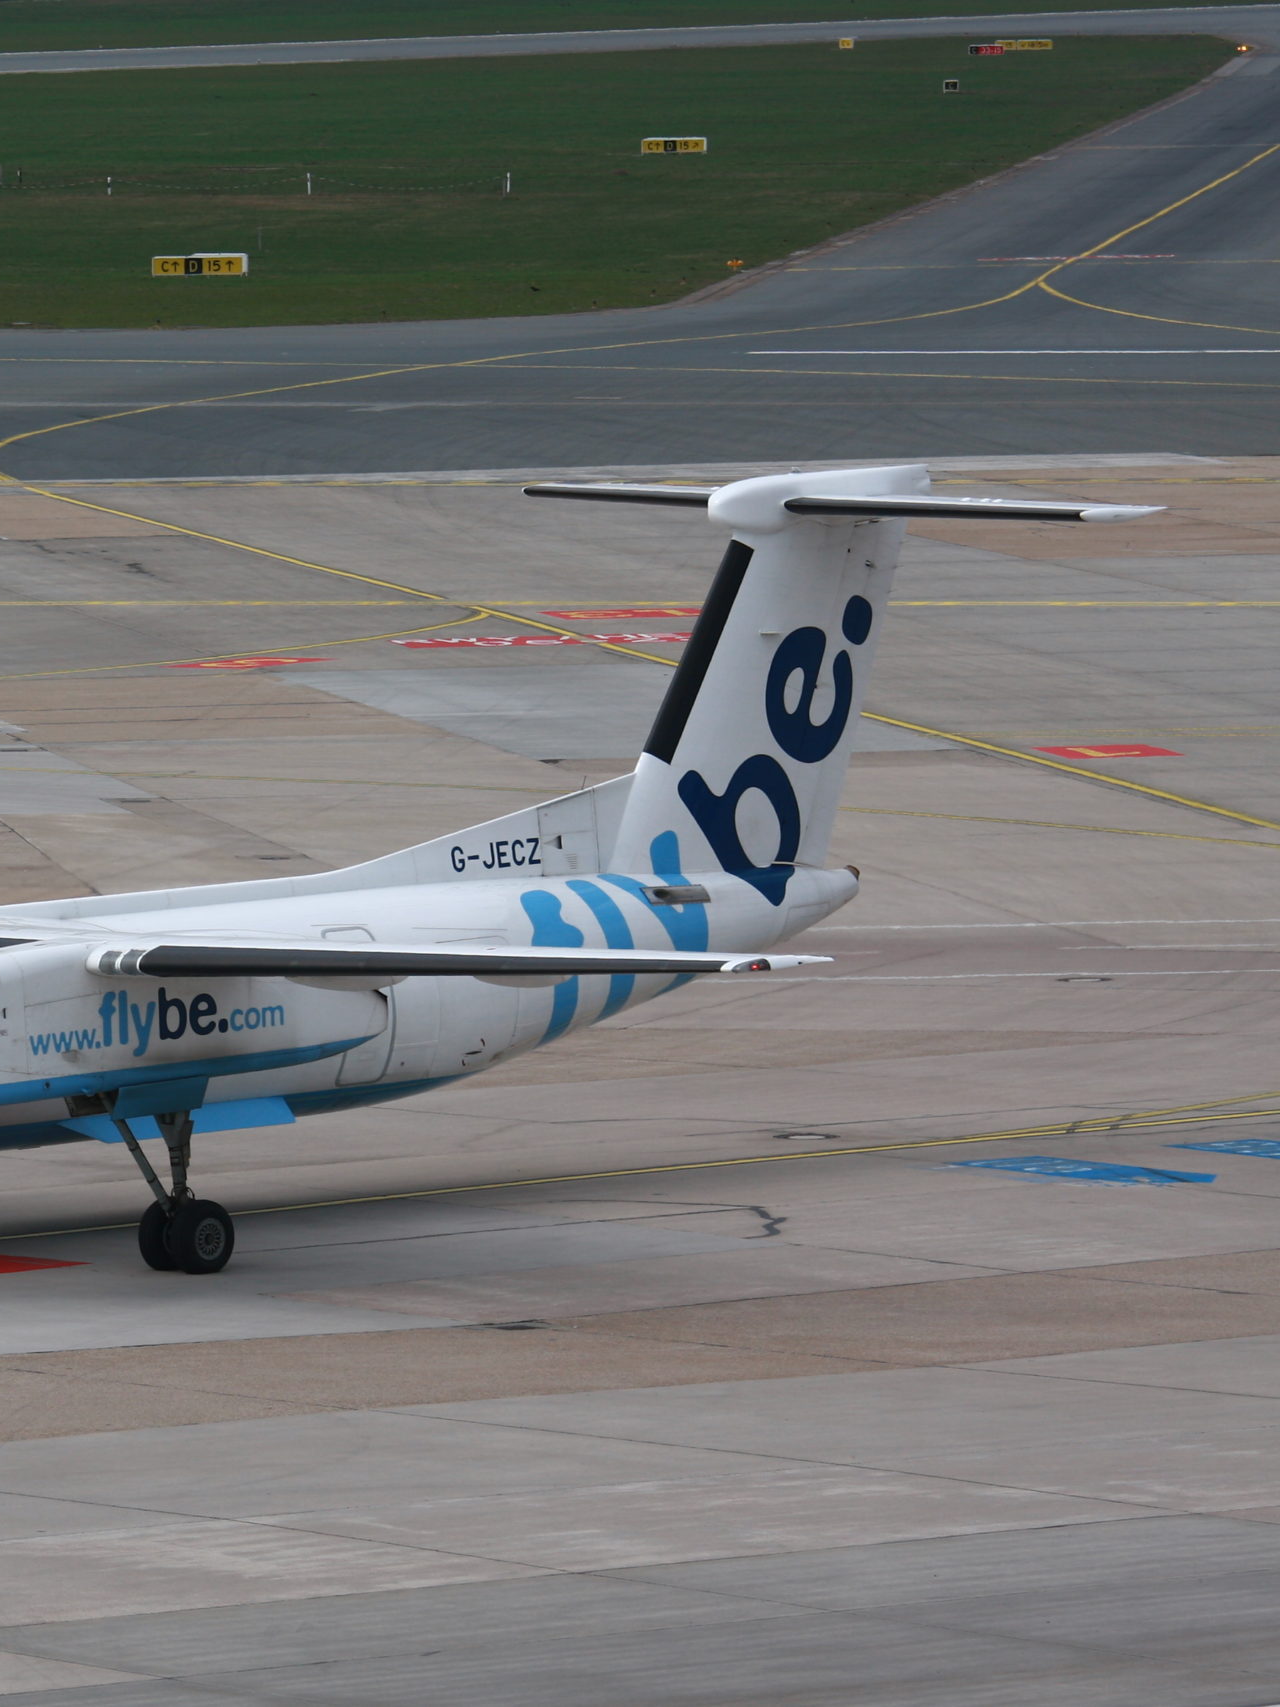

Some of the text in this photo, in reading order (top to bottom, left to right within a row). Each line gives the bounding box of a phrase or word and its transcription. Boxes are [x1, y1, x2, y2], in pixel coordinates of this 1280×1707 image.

[647, 142, 654, 151] C
[679, 141, 689, 150] 15
[161, 260, 221, 272] C D 15
[450, 837, 542, 873] G-JECZ
[29, 986, 285, 1058] www.flybe.com
